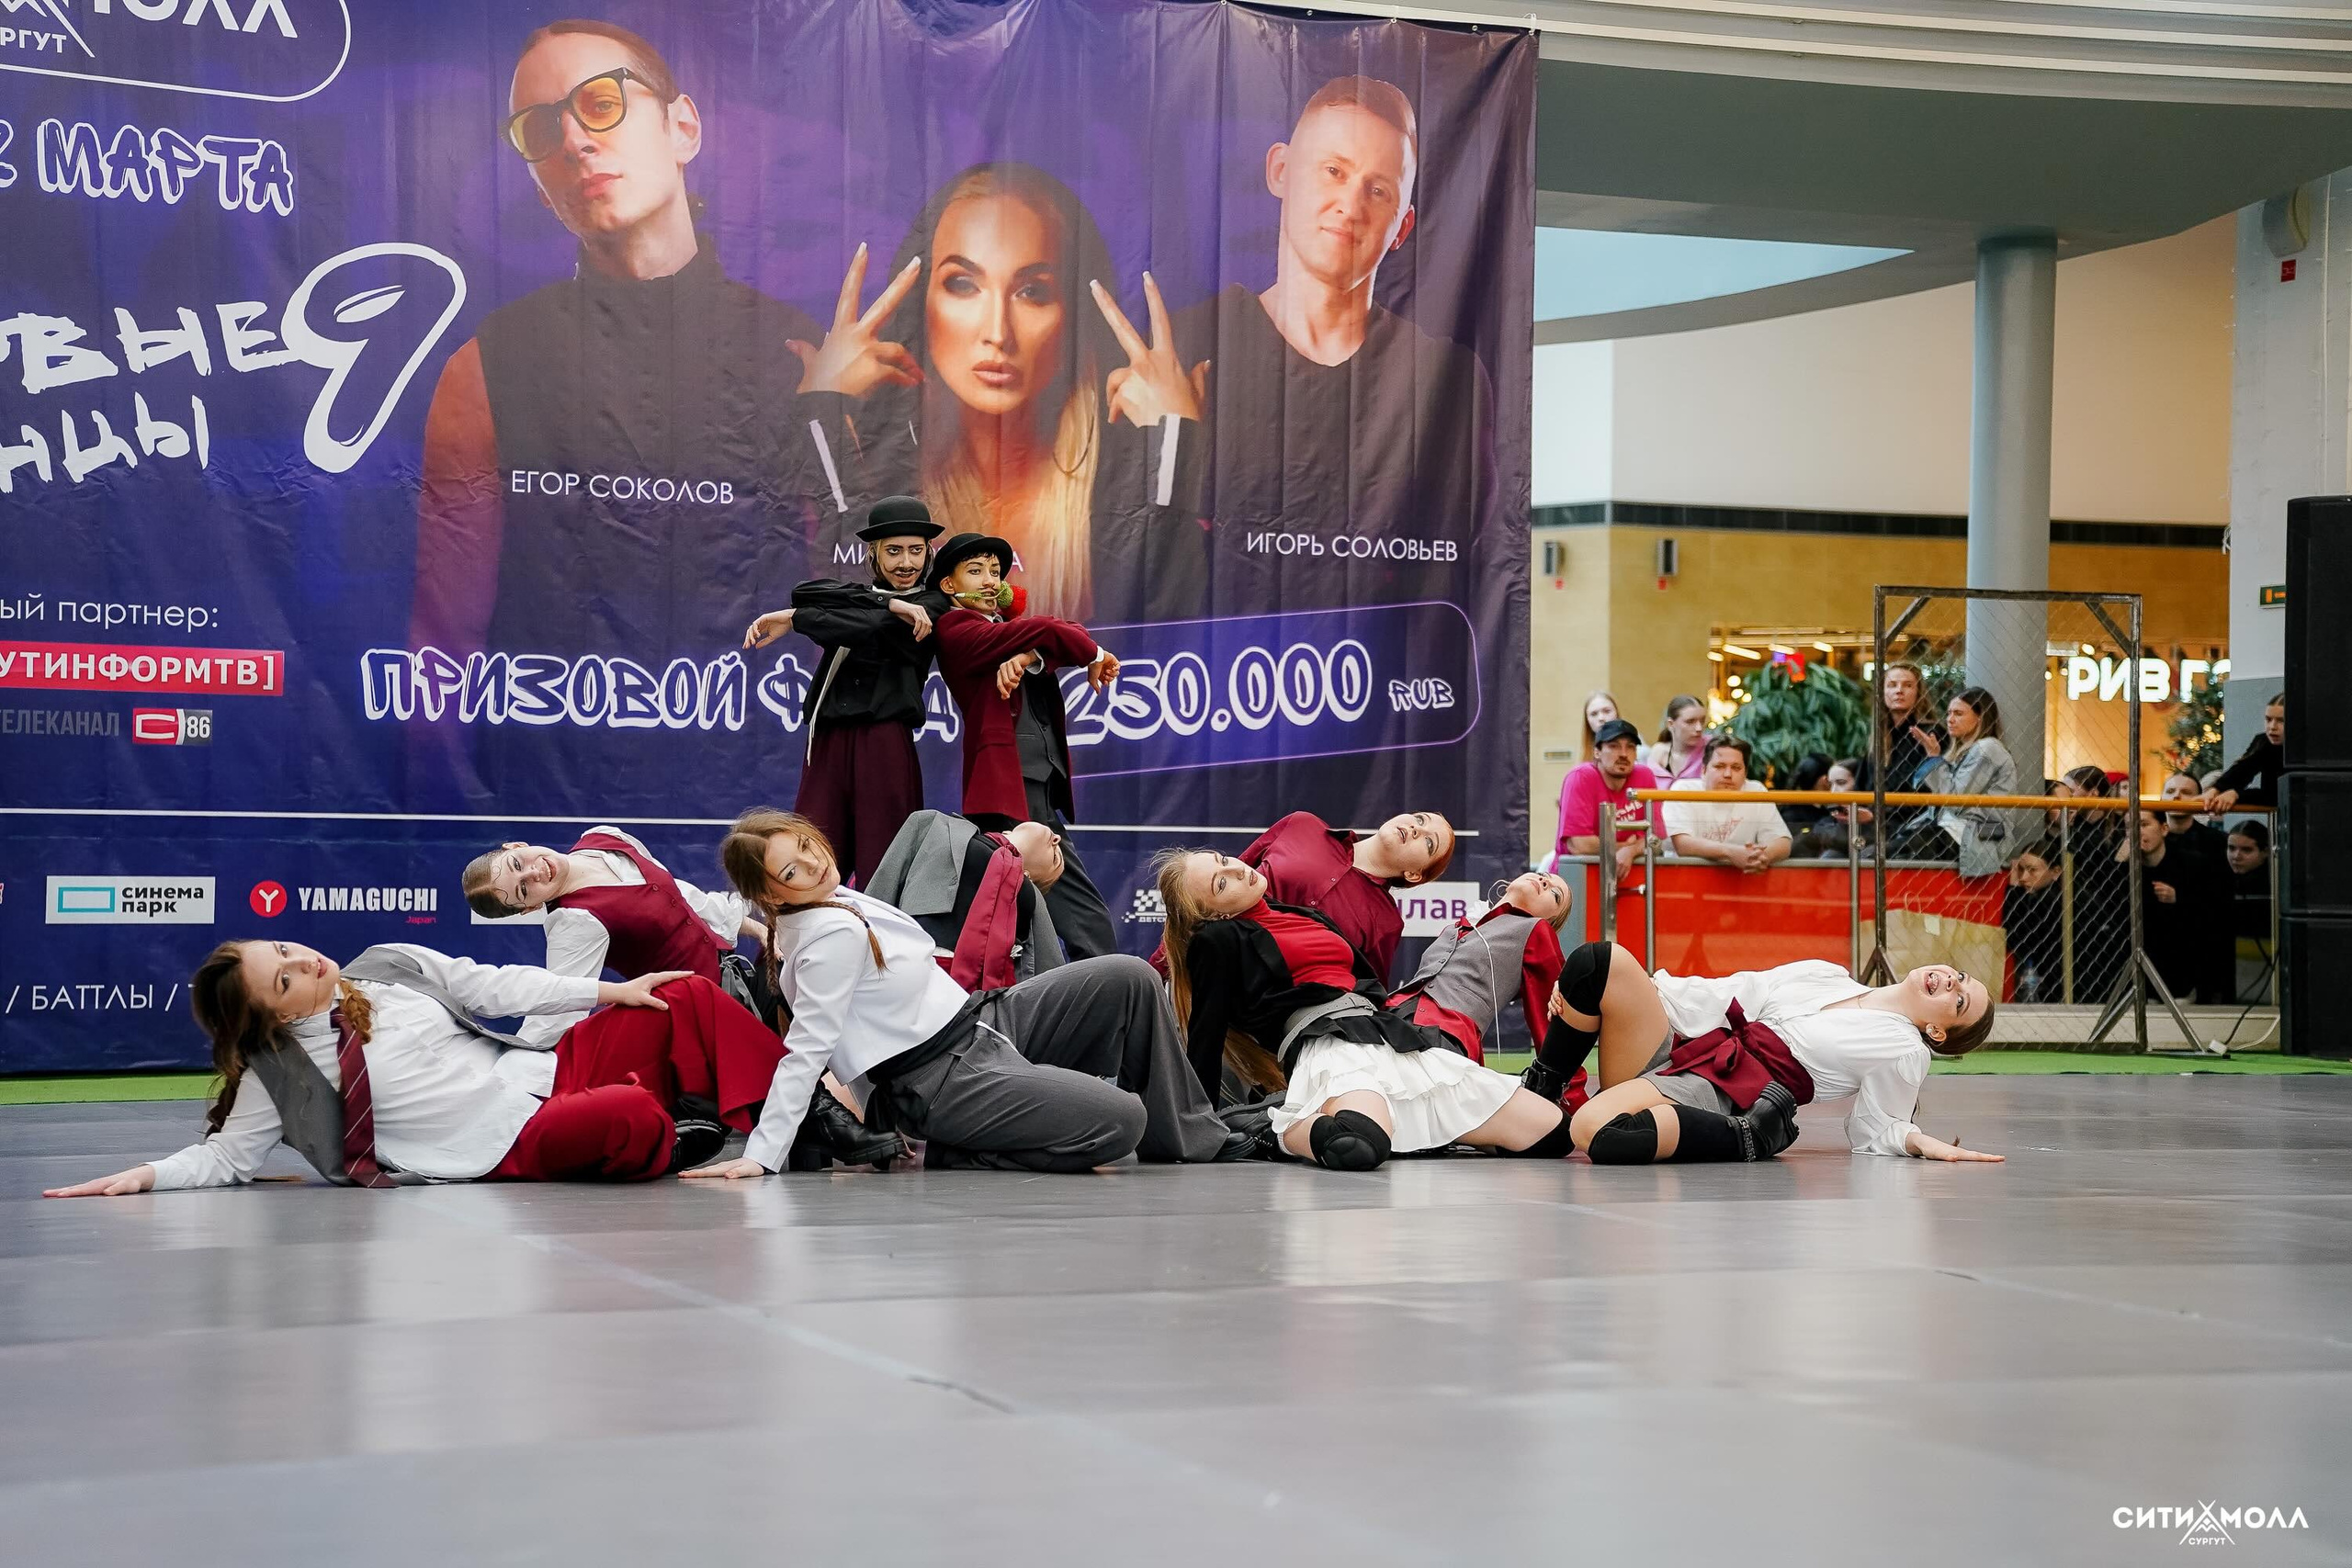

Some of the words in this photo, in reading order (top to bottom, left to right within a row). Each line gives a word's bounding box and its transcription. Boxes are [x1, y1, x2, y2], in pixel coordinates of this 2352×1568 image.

[37, 118, 294, 216] МАРТА
[0, 301, 294, 395] ВЫЕ
[512, 469, 580, 495] ЕГОР
[589, 474, 734, 504] СОКОЛОВ
[1248, 532, 1325, 556] ИГОРЬ
[1331, 535, 1458, 561] СОЛОВЬЕВ
[58, 602, 218, 633] партнер:
[360, 646, 747, 732] ПРИЗОВОЙ
[1058, 638, 1373, 746] 250.000
[1387, 678, 1455, 712] RUB
[2067, 656, 2172, 703] РИВ
[0, 708, 119, 736] ЕЛЕКАНАЛ
[121, 886, 204, 899] синема
[298, 887, 437, 911] YAMAGUCHI
[121, 900, 177, 918] парк
[32, 984, 153, 1010] БАТТЛЫ
